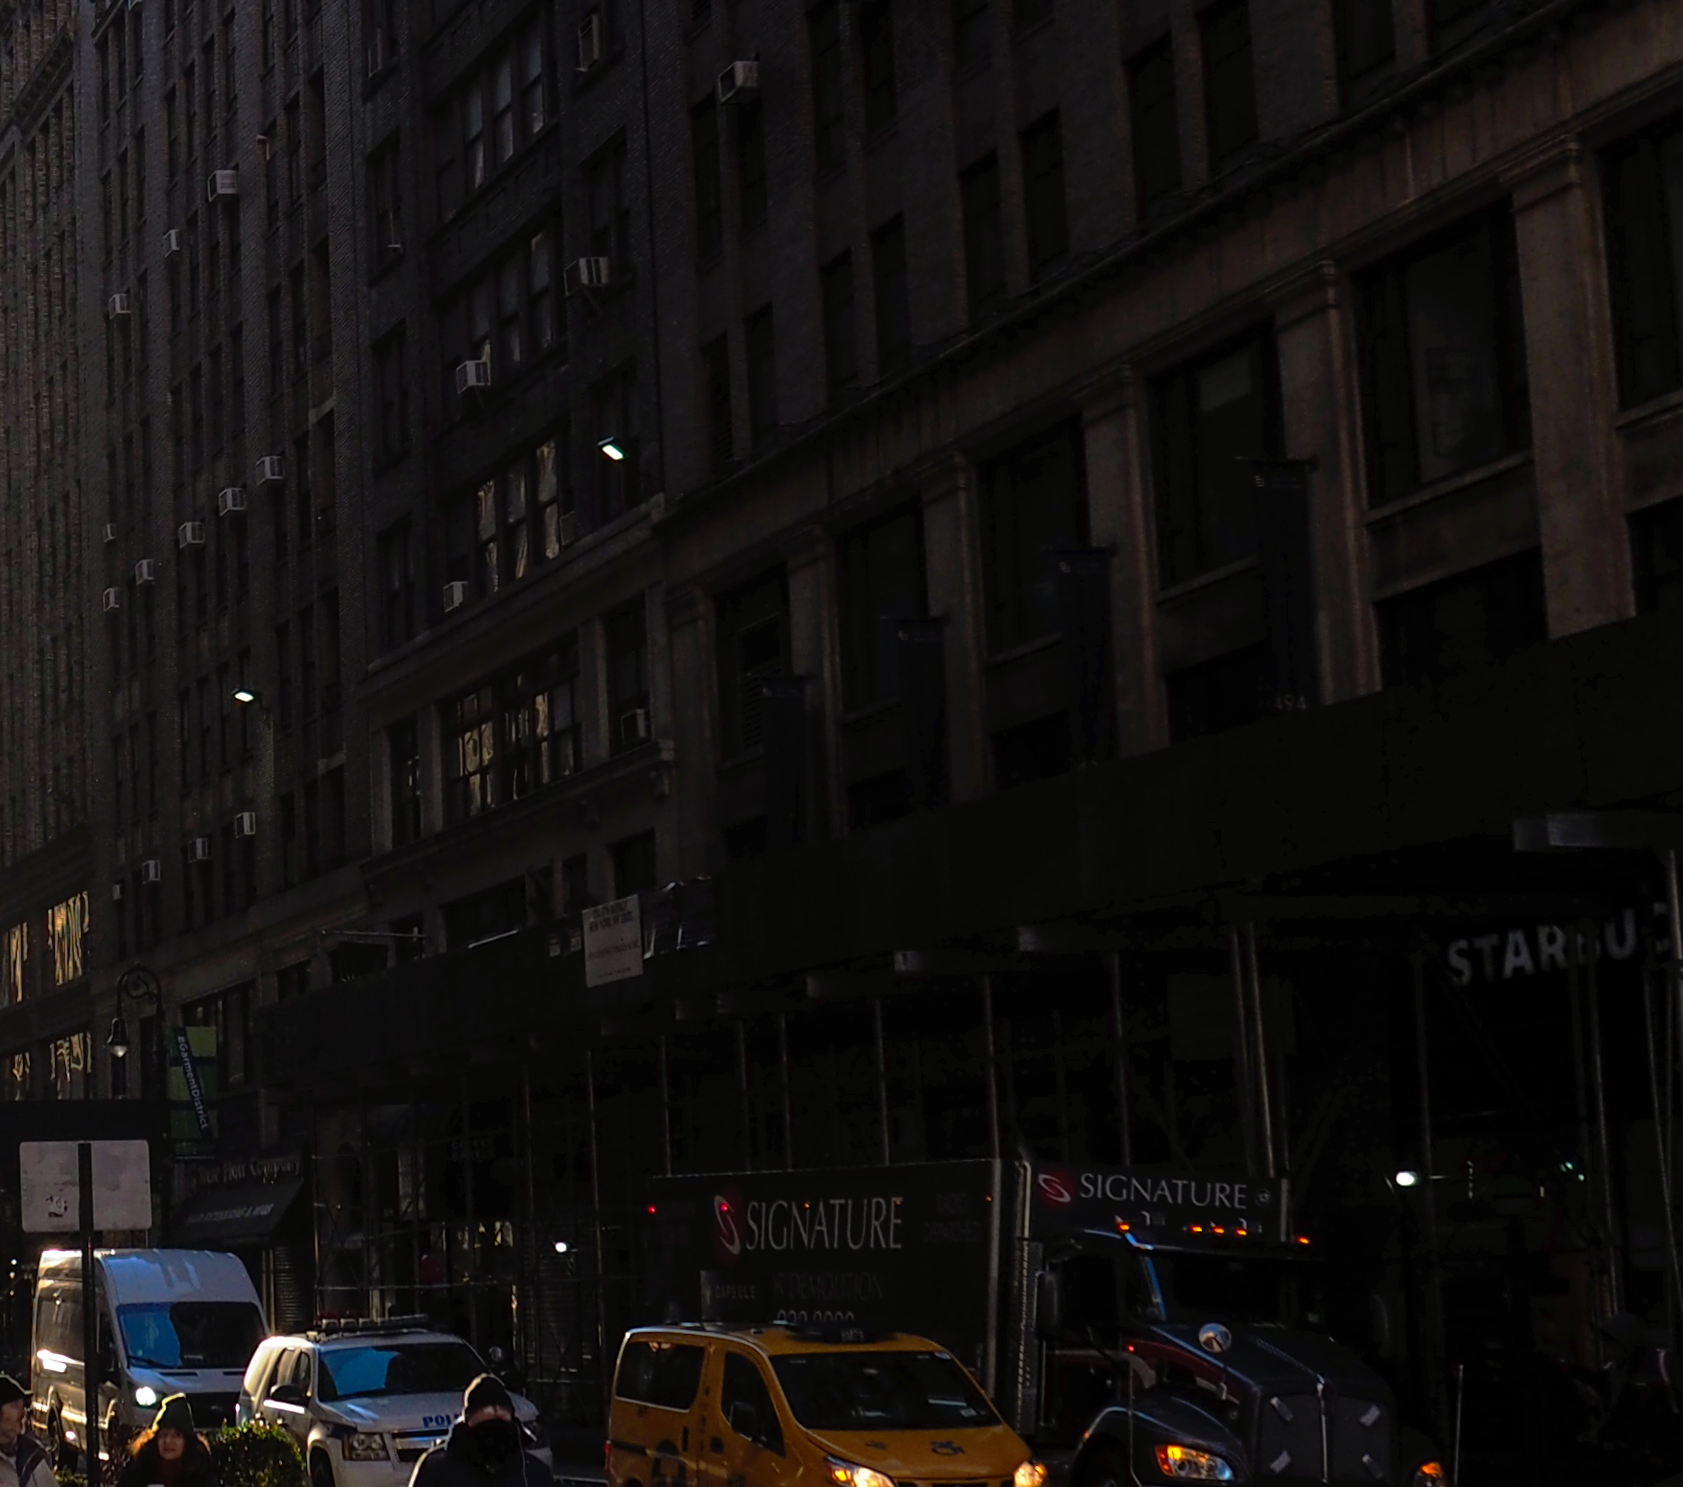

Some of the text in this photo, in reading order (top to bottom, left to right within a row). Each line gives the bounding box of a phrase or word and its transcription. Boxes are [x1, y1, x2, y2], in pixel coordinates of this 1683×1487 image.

[177, 1035, 209, 1130] #GarmentDistrict
[249, 1155, 300, 1179] Company
[1080, 1172, 1248, 1209] SIGNATURE
[745, 1196, 904, 1251] SIGNATURE
